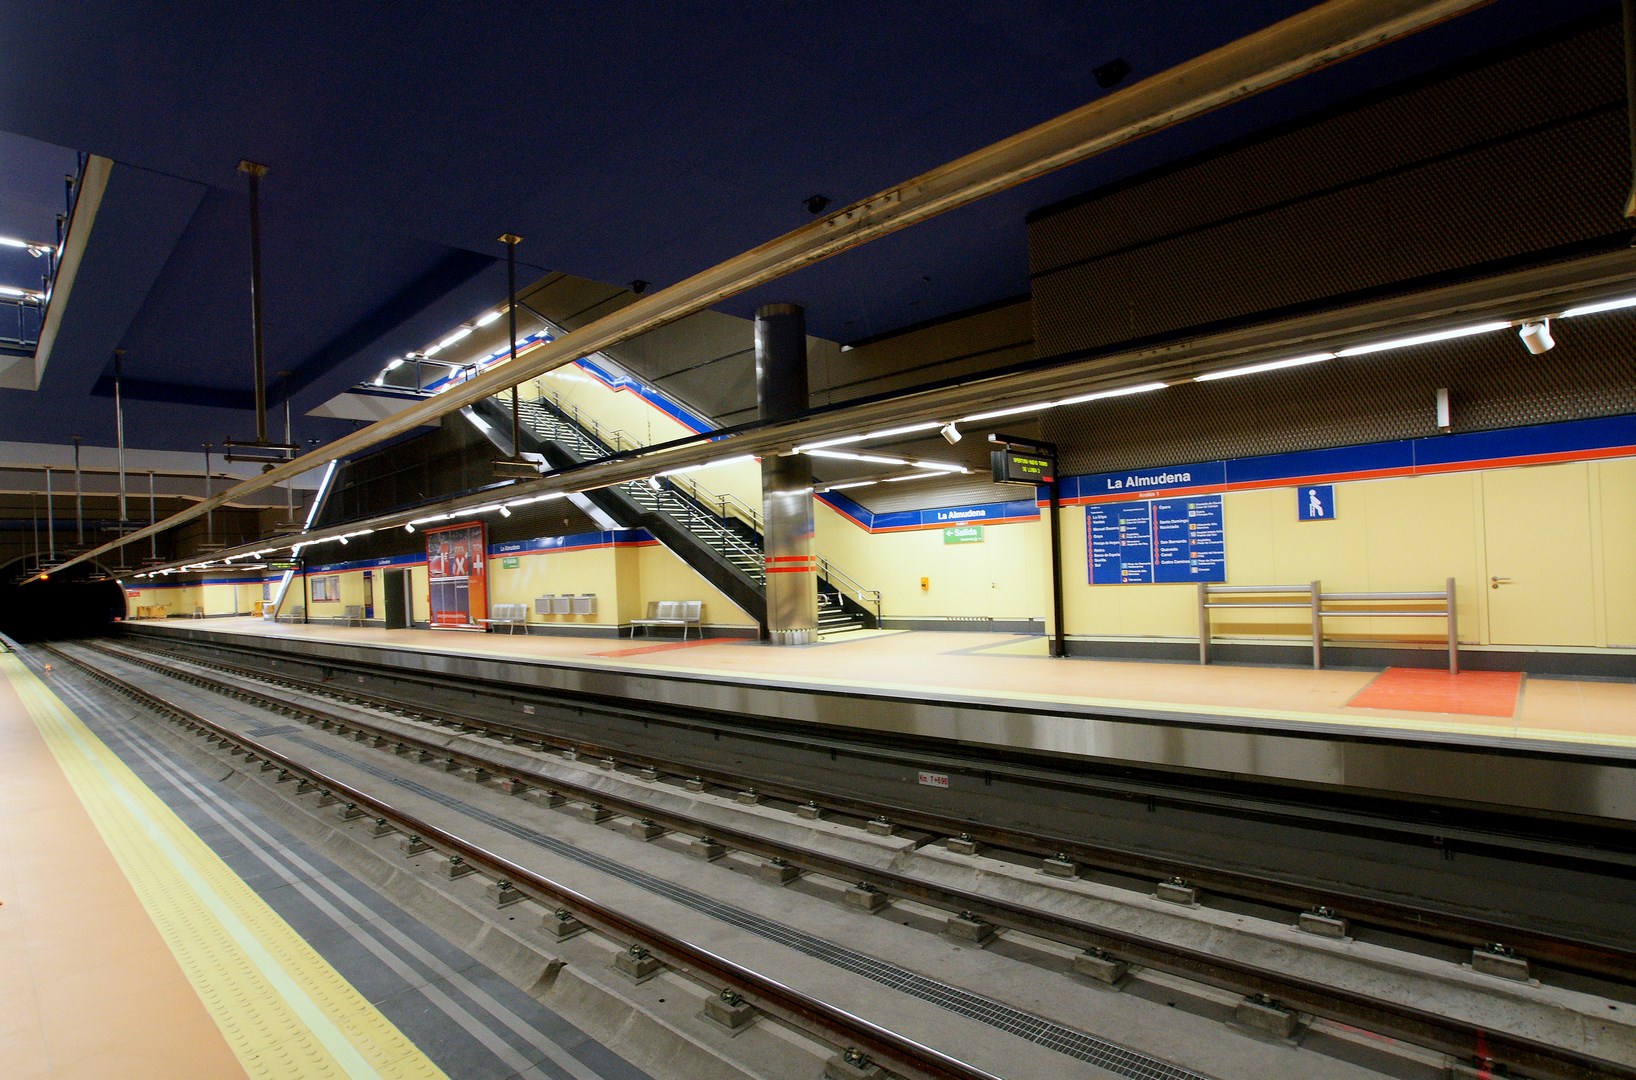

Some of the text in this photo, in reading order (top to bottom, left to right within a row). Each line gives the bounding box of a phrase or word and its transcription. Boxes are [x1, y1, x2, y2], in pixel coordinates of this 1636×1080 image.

[1107, 472, 1191, 489] La Almudena
[948, 509, 986, 519] Almudena
[954, 528, 978, 537] Salida
